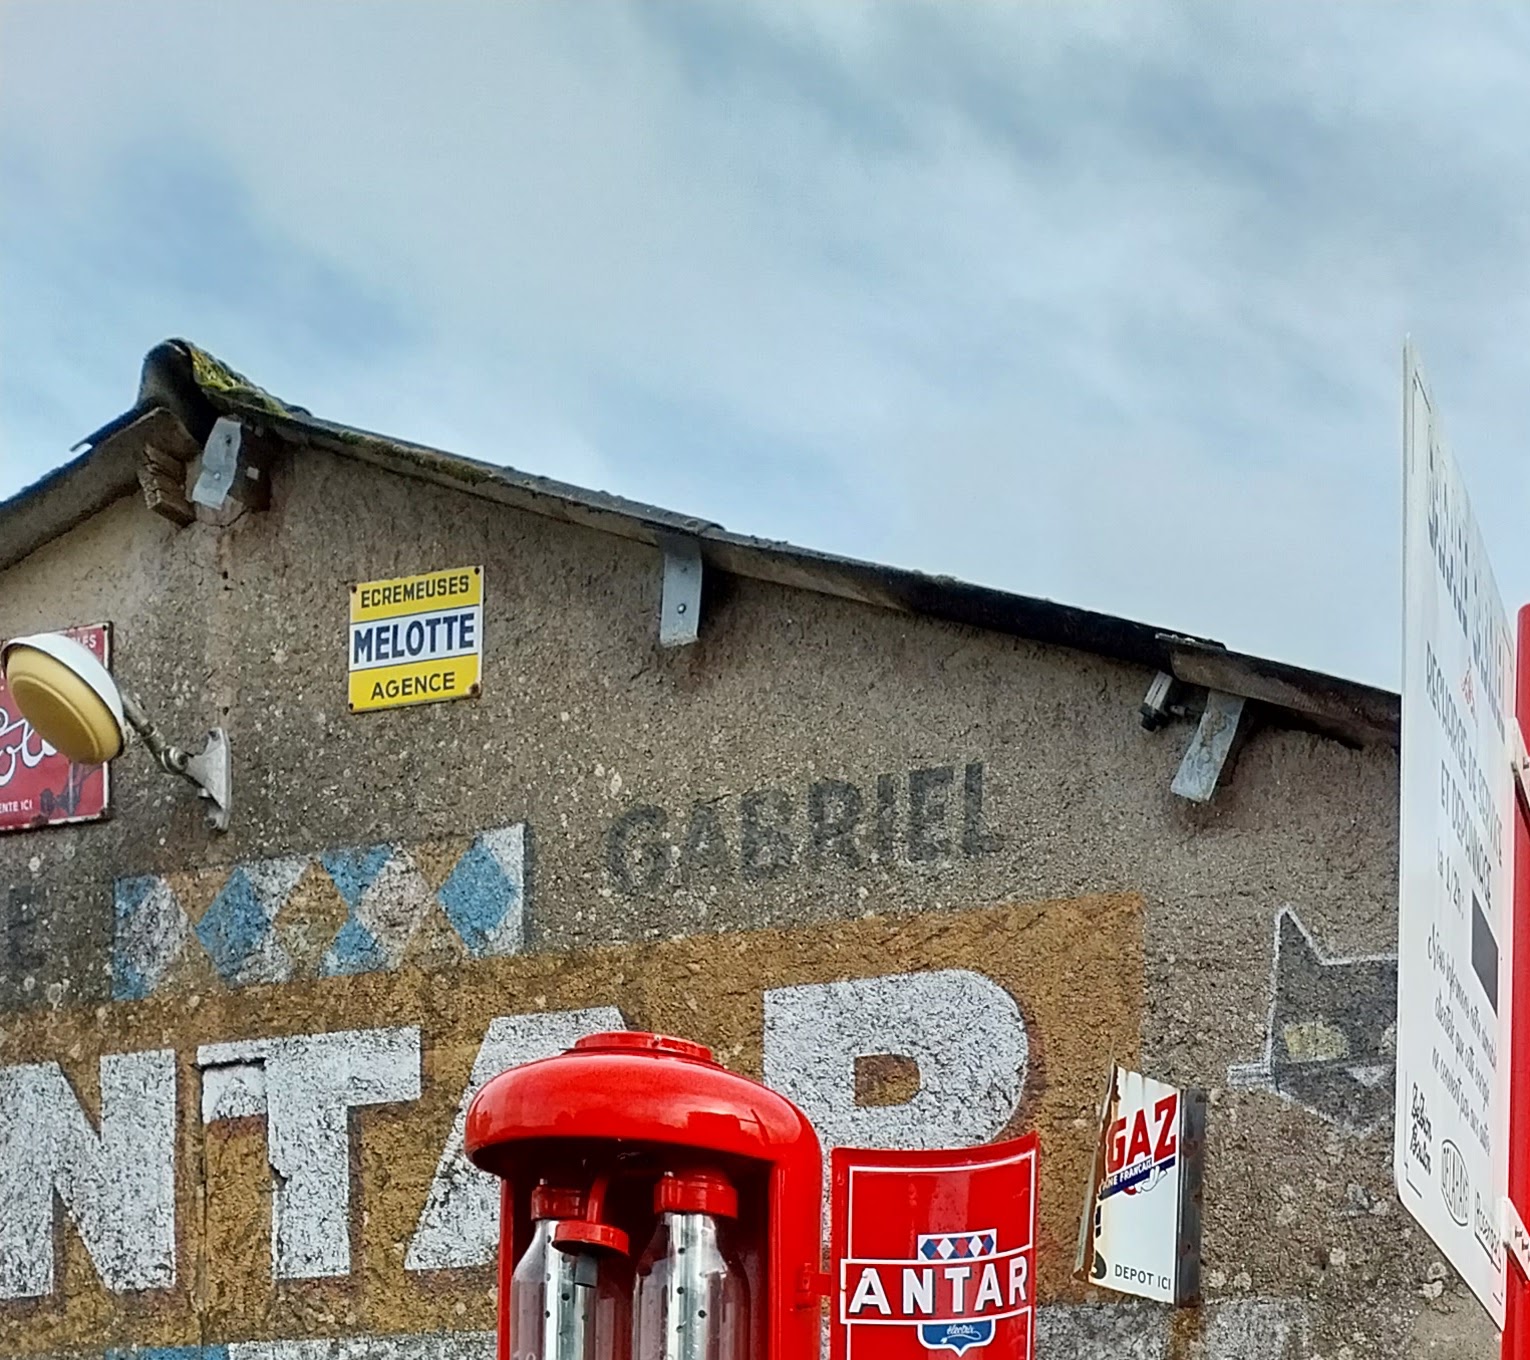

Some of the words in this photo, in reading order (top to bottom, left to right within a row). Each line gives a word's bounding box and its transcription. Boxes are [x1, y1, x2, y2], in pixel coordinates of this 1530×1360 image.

[361, 575, 469, 609] ECREMEUSES
[353, 612, 475, 665] MELOTTE
[370, 671, 456, 701] AGENCE
[1106, 1094, 1178, 1176] GAZ
[848, 1255, 1028, 1316] ANTAR
[1114, 1264, 1155, 1286] DEPOT
[1157, 1275, 1172, 1291] ICI
